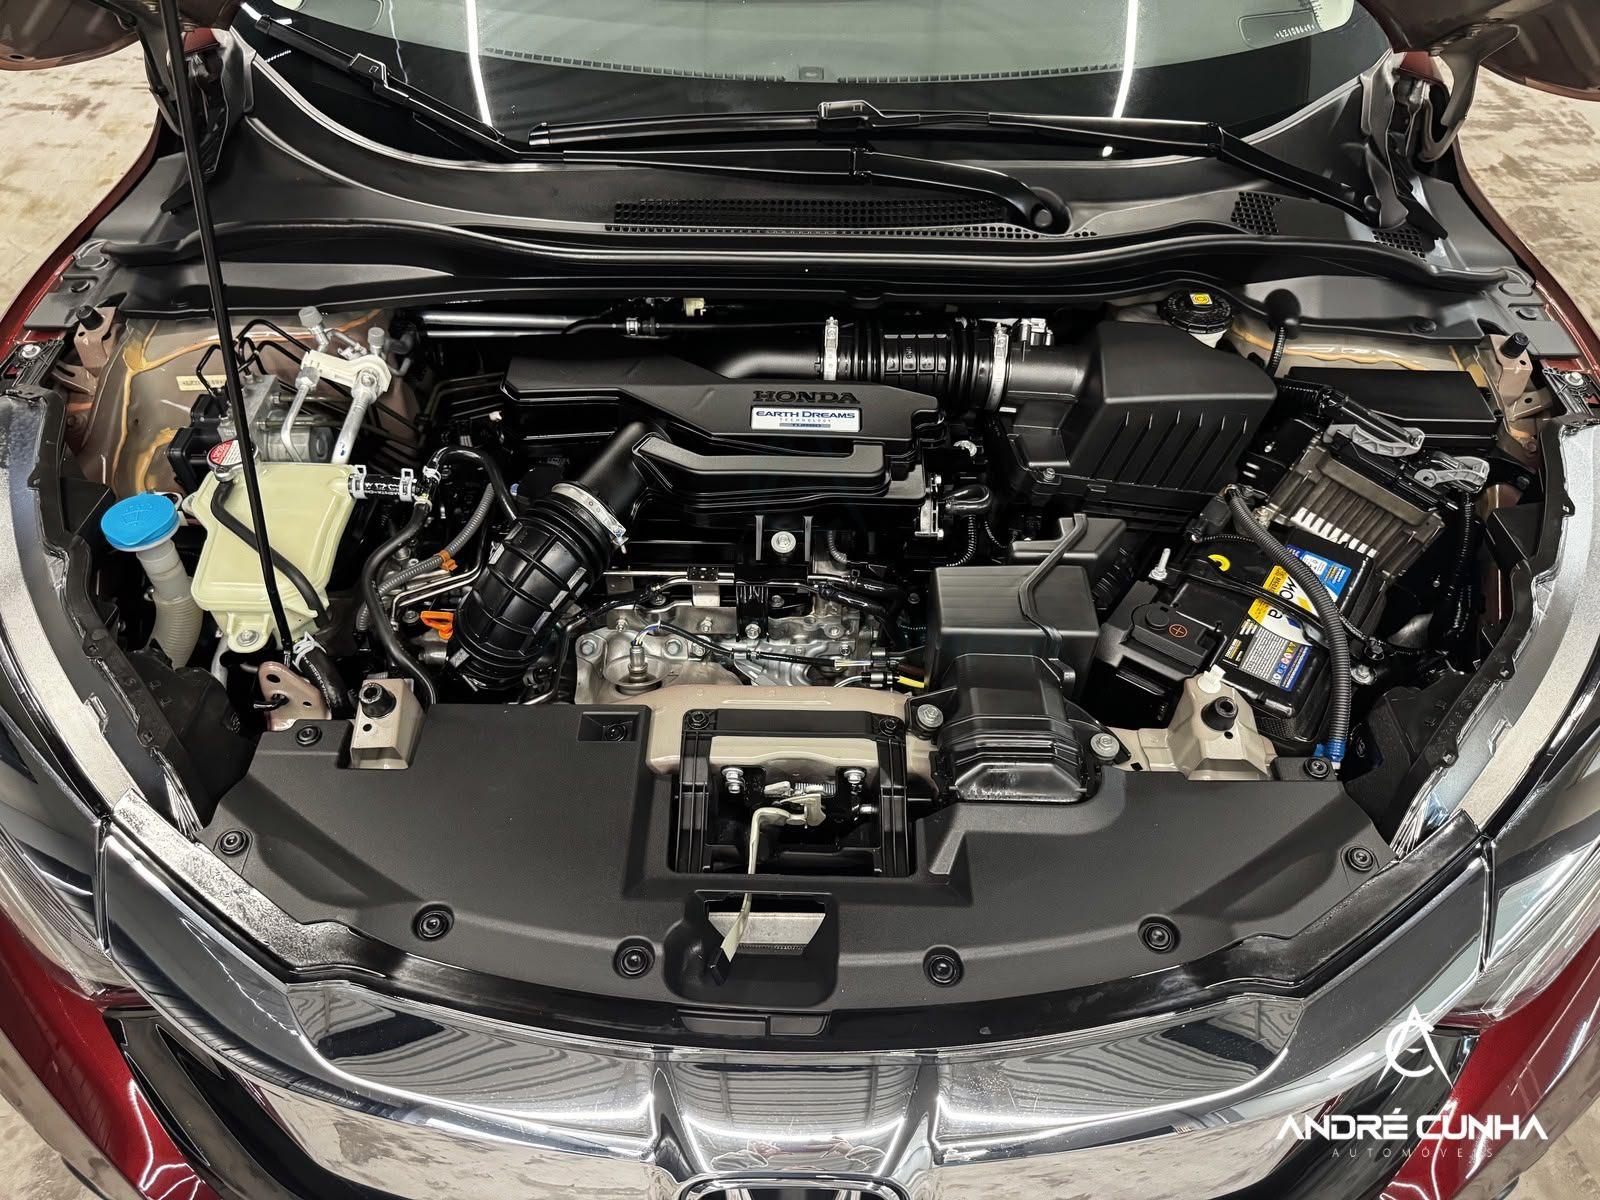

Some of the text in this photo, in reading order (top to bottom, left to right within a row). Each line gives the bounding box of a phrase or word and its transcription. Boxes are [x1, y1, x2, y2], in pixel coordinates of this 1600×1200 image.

[753, 390, 861, 404] HONDA
[756, 410, 856, 419] EARTH DREAMS
